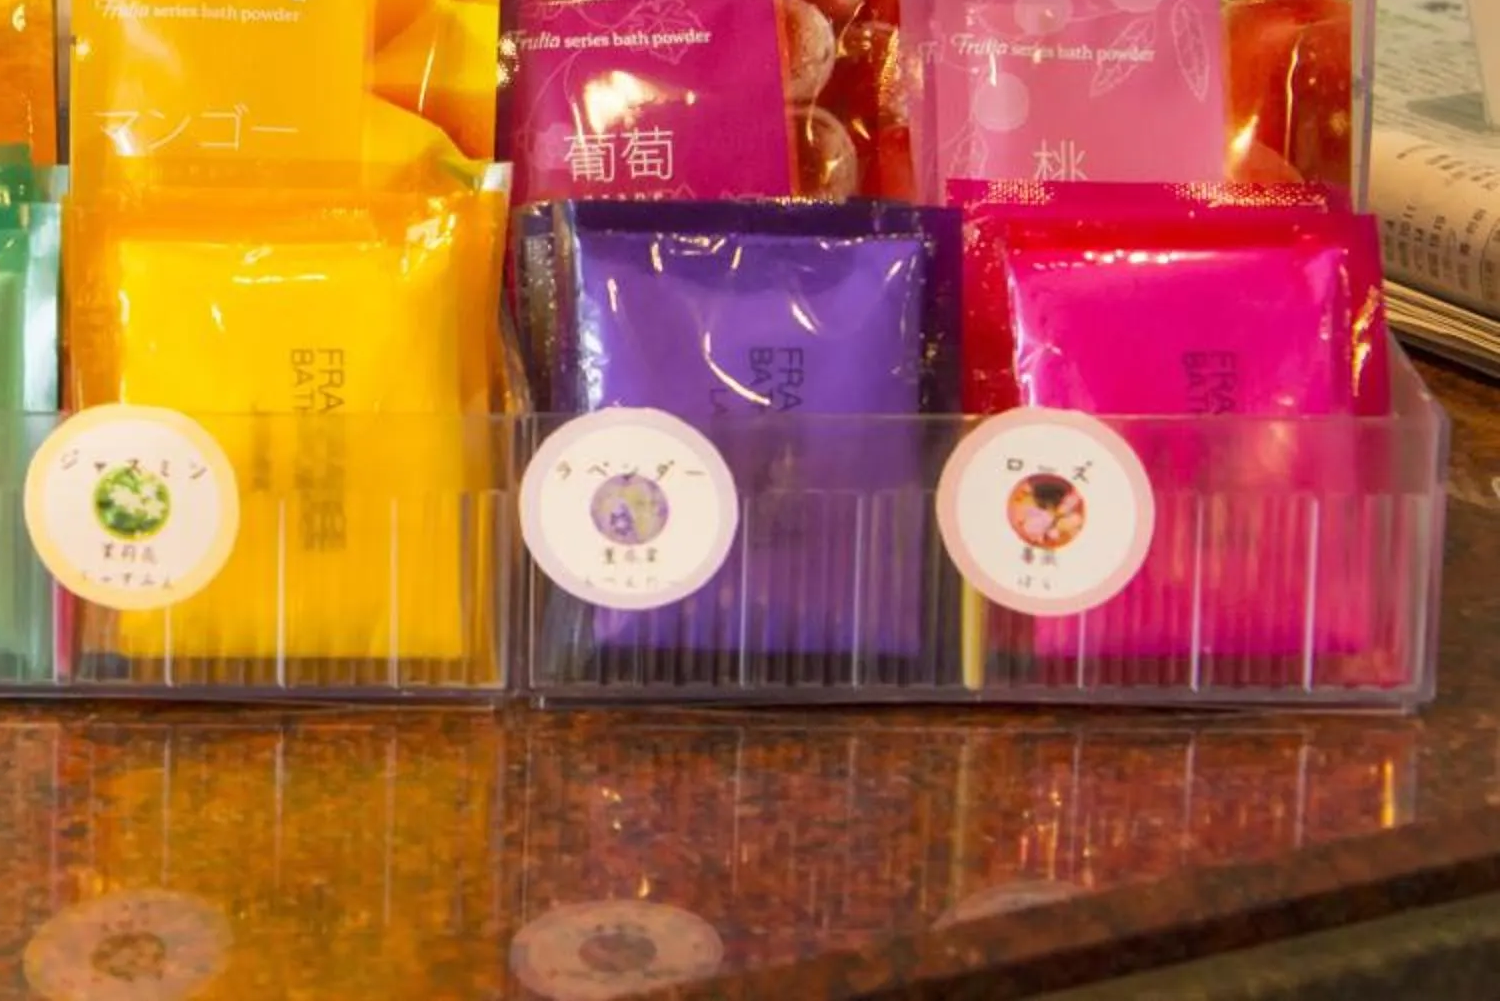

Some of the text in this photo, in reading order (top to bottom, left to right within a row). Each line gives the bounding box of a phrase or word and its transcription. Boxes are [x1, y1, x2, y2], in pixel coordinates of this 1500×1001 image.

[153, 4, 198, 19] series
[240, 6, 300, 24] powder
[564, 33, 610, 48] series
[613, 31, 650, 47] bath
[652, 28, 712, 48] powder
[1057, 44, 1093, 60] bath
[1096, 46, 1156, 67] powder
[95, 103, 300, 154] マンゴー
[563, 126, 674, 183] 葡萄
[1033, 139, 1088, 182] 桃
[1006, 458, 1094, 483] ローズ
